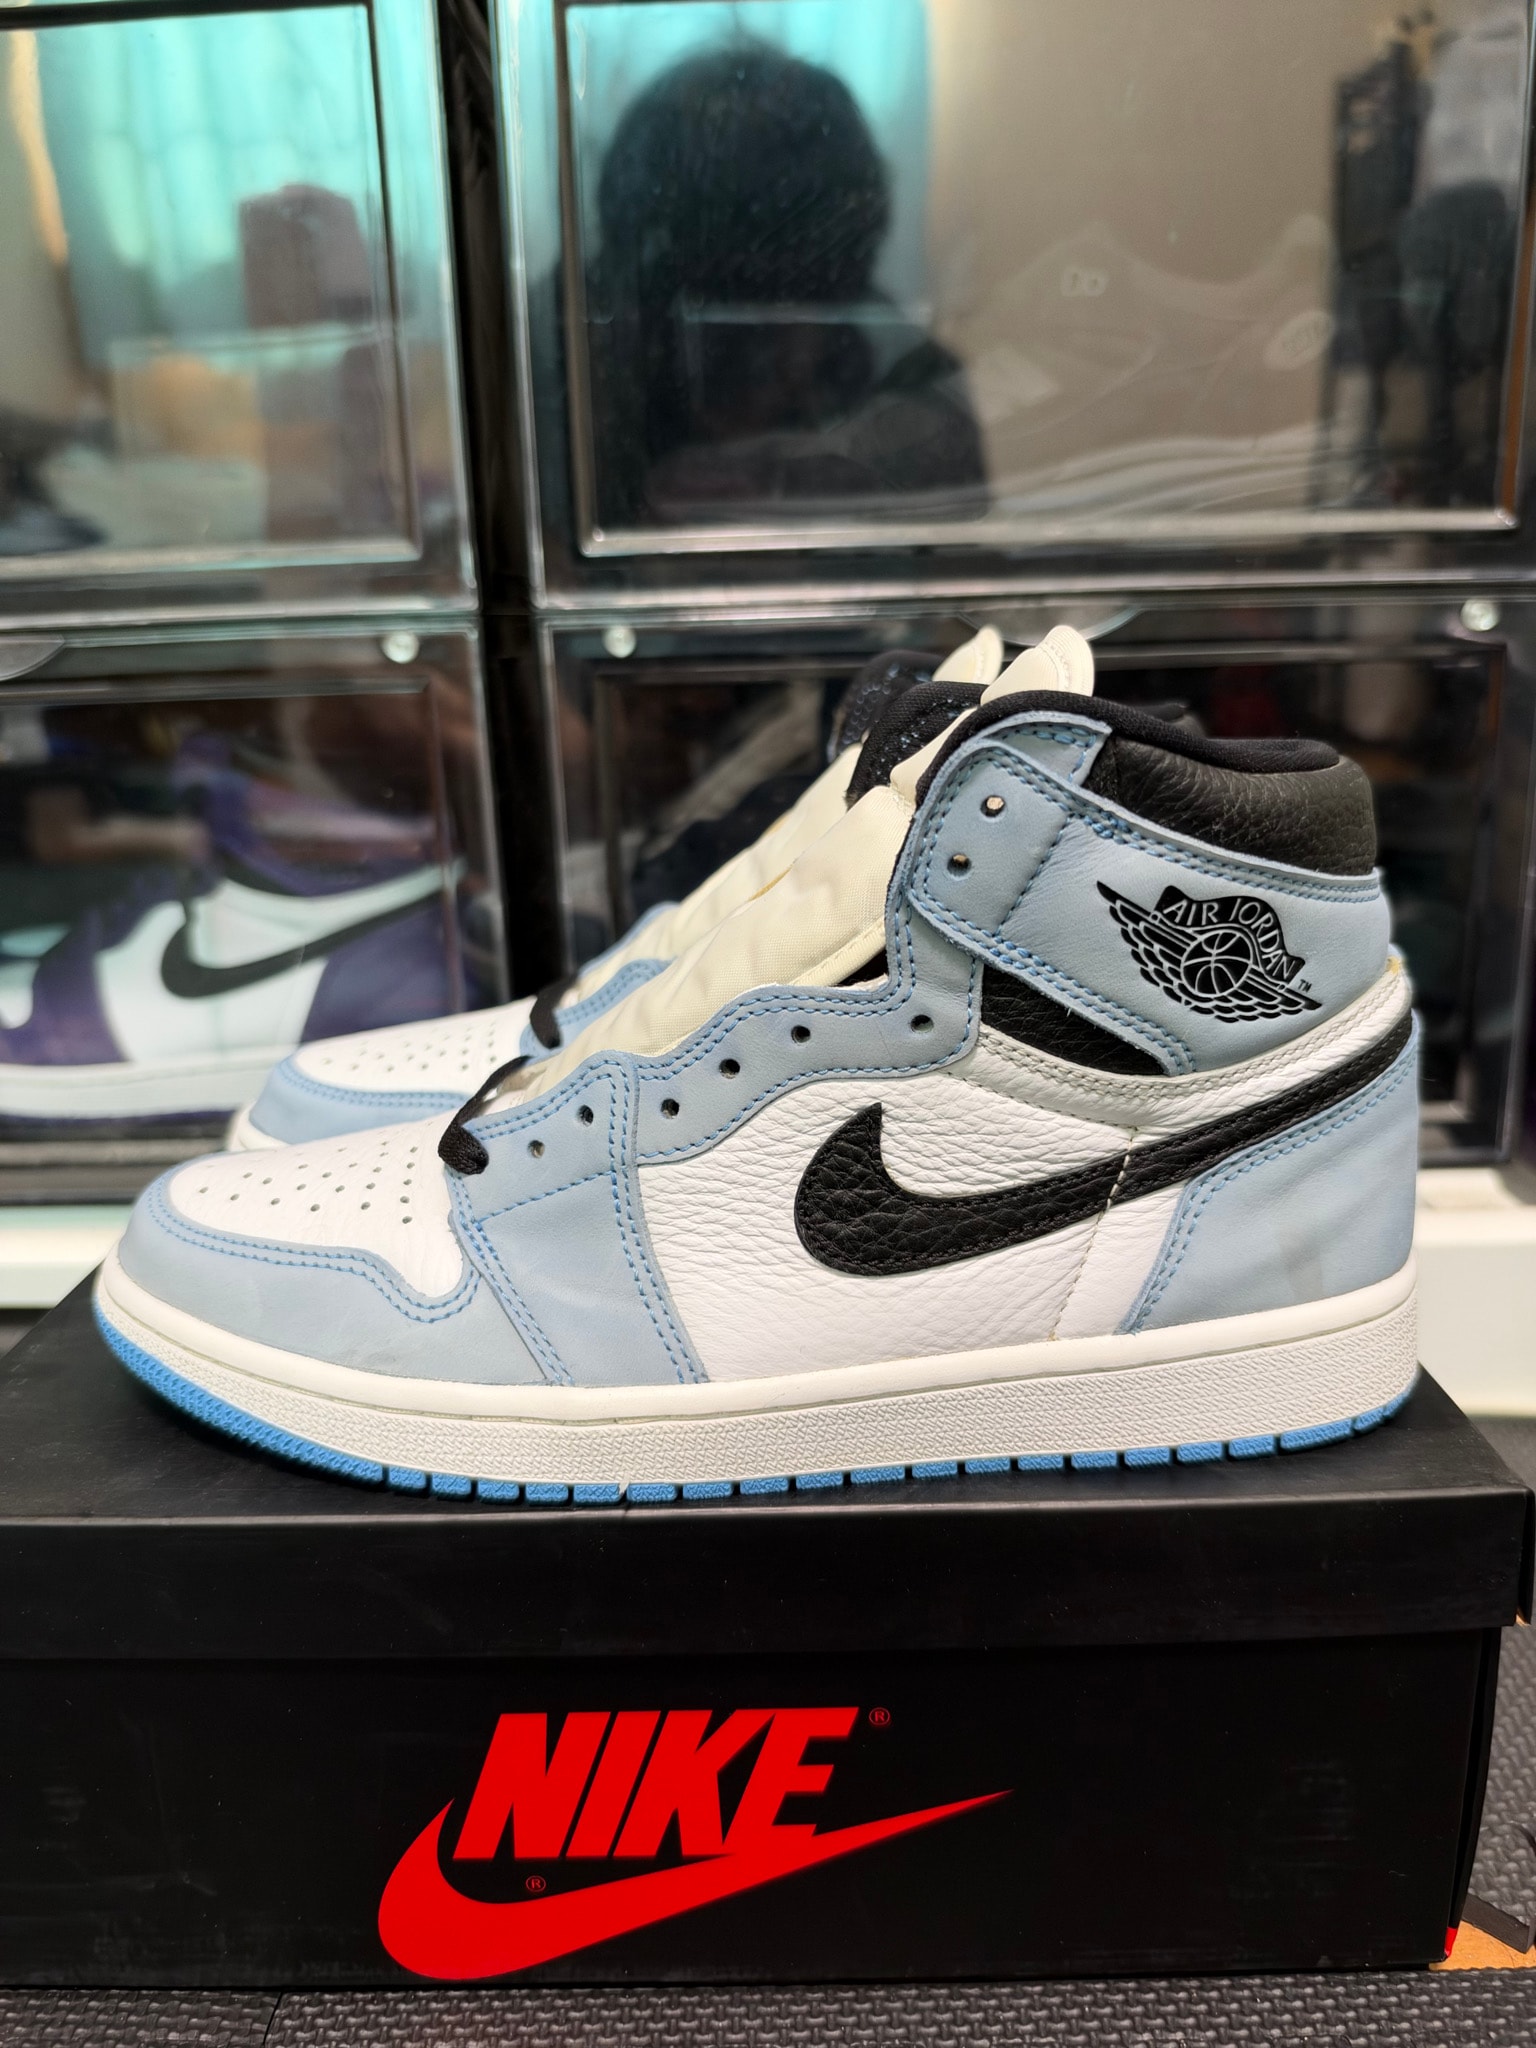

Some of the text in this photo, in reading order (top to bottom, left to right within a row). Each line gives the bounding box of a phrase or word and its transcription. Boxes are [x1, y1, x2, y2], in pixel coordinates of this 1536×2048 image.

[1163, 898, 1297, 980] AIR JORDAN
[453, 1707, 860, 1860] NIKE
